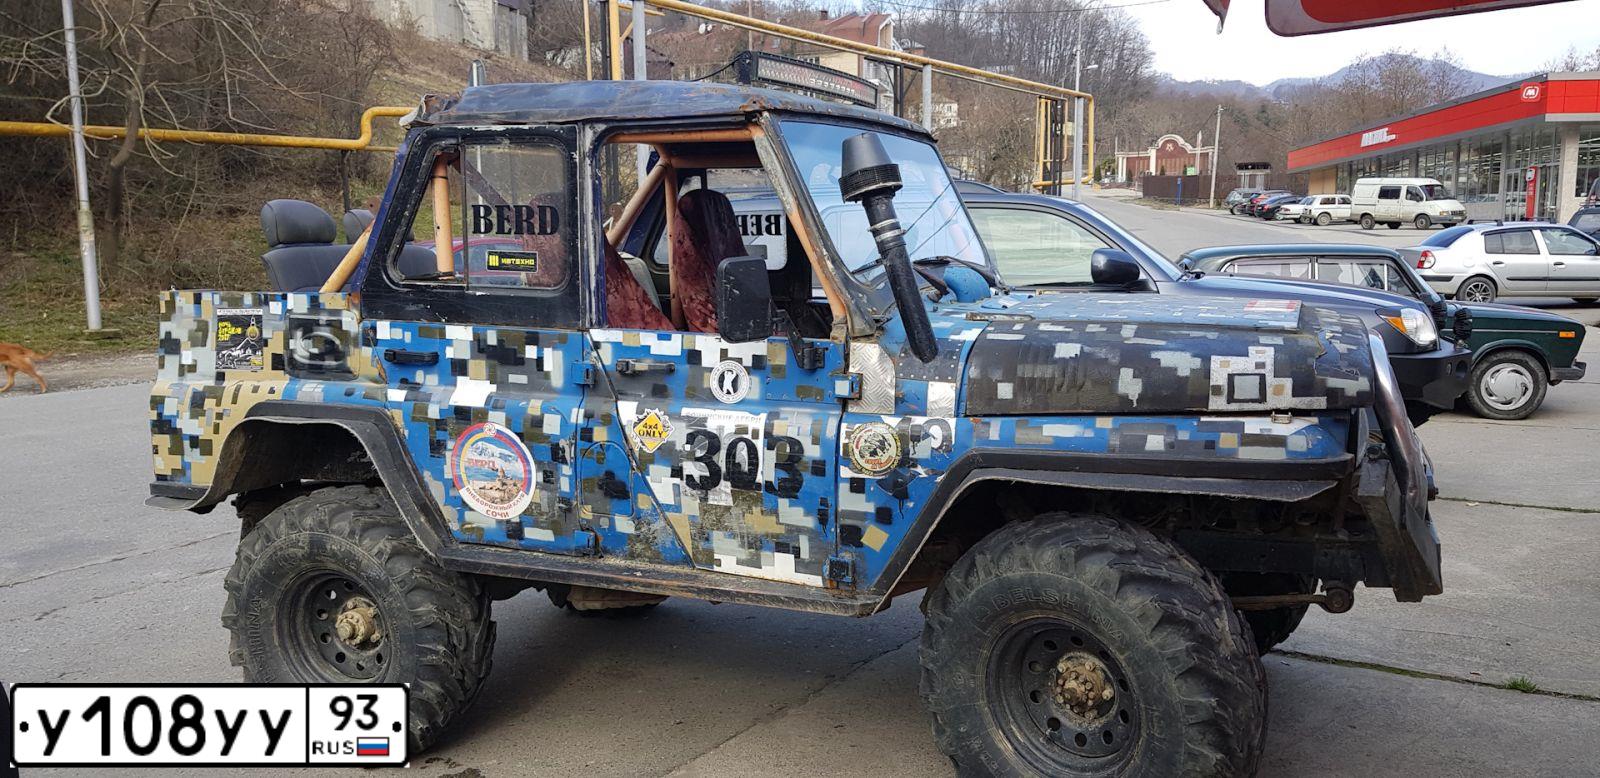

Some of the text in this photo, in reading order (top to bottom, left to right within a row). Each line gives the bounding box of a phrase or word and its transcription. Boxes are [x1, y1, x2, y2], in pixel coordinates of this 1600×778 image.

[472, 205, 560, 235] BERD
[638, 429, 664, 438] ONLY
[642, 422, 658, 430] 4x4
[684, 430, 804, 499] 303
[486, 509, 510, 518] СОЧИ
[991, 587, 1126, 641] BELSHINA
